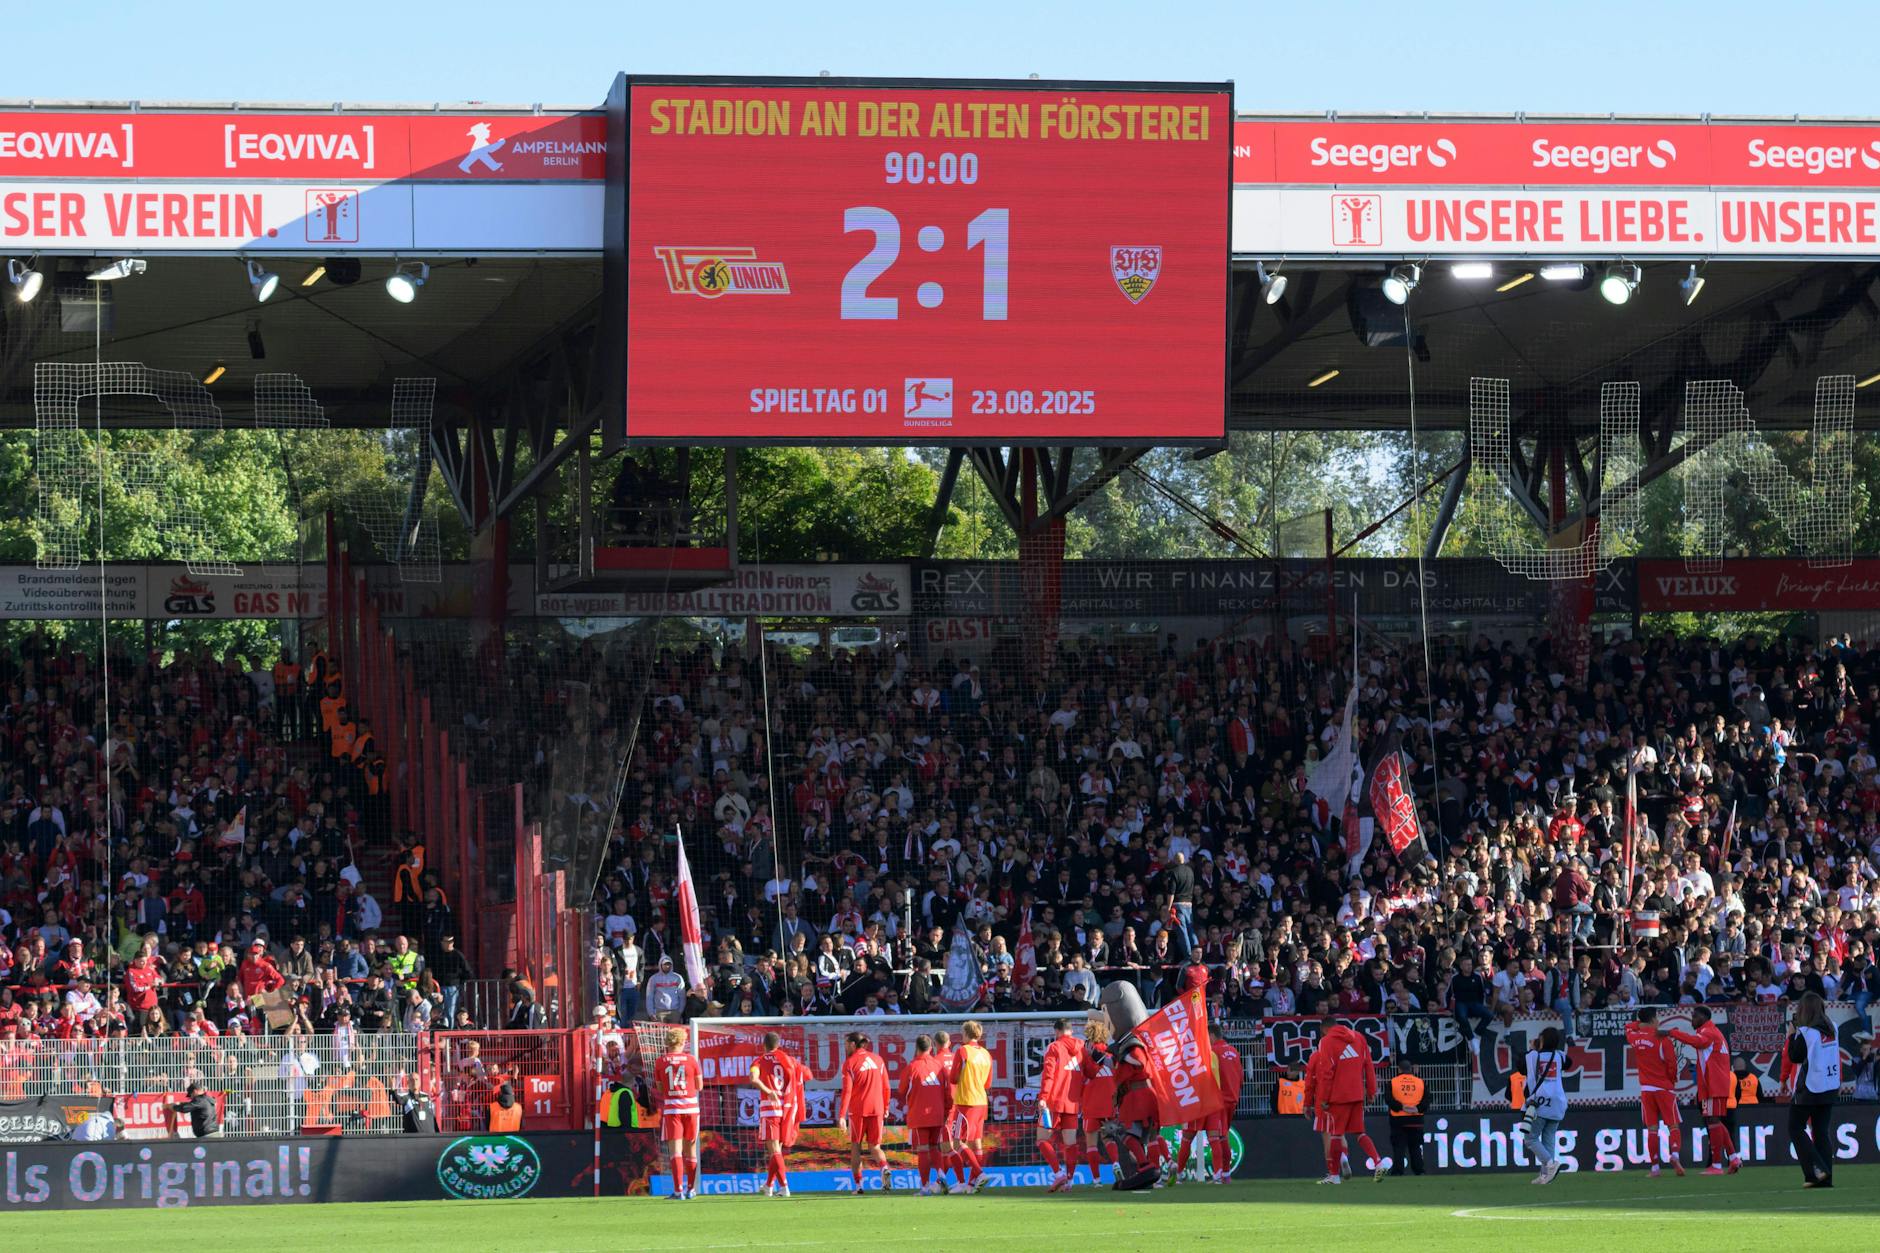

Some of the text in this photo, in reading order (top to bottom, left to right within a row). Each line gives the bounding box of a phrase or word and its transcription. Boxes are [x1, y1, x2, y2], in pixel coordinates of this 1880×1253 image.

[650, 97, 1209, 140] STADION AN DER ALTEN FÖRSTEREI
[512, 141, 607, 154] AMPELMANN
[1310, 137, 1422, 173] Seeger
[1532, 138, 1642, 174] Seeger
[1748, 139, 1857, 174] Seeger
[543, 157, 579, 166] BERLIN
[885, 152, 979, 185] 90:00
[4, 192, 279, 238] SER VEREIN.
[1406, 198, 1704, 243] UNSERE LIEBE.
[1722, 201, 1877, 243] UNSERE
[729, 265, 786, 290] UNION
[750, 388, 888, 413] SPIELTAG 01
[971, 390, 1096, 414] 23.08.2025
[1098, 567, 1153, 588] WIR
[1656, 576, 1737, 596] VELUX
[1776, 572, 1833, 602] Bringt
[164, 594, 215, 614] GAS
[233, 592, 280, 614] GAS
[851, 590, 900, 612] GAS
[921, 600, 986, 610] CAPITAL
[1592, 1012, 1633, 1020] DU BIST
[1163, 999, 1207, 1077] EISERN
[665, 1065, 687, 1091] 14
[1153, 1030, 1200, 1107] UNION
[530, 1078, 555, 1093] Tor
[534, 1099, 551, 1114] 11
[1595, 1118, 1672, 1172] gut
[6, 1145, 311, 1208] ls Original!
[442, 1165, 535, 1198] EBERSWALDER
[1010, 1170, 1085, 1187] raisn
